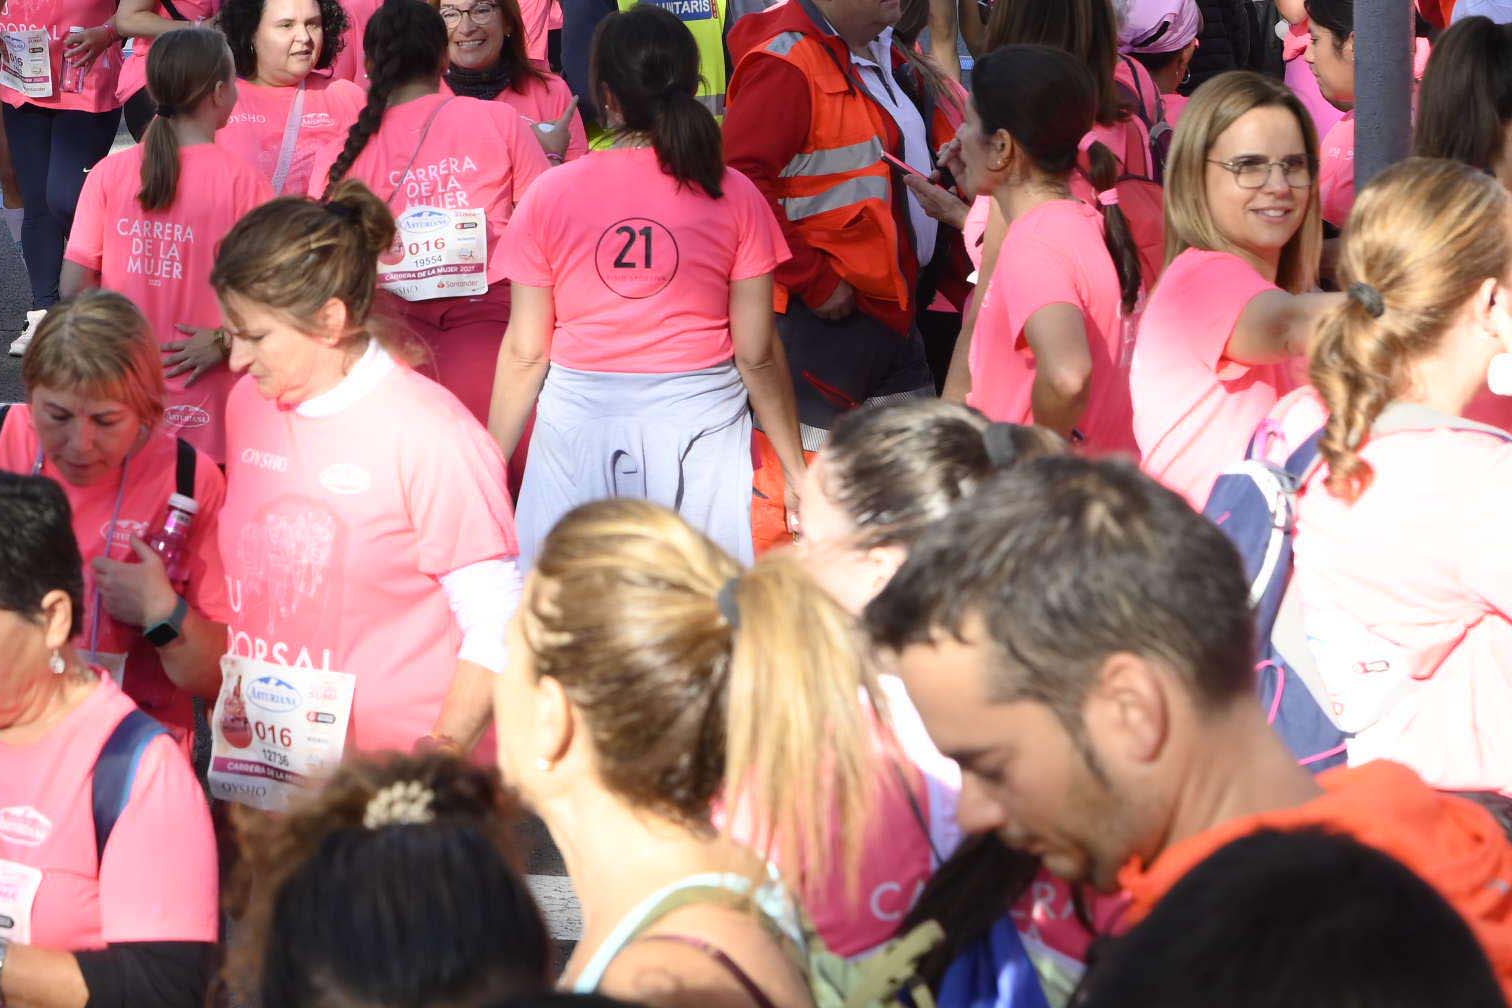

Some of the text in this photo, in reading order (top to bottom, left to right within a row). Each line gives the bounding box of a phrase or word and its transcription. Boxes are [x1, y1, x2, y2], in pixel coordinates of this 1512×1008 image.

[389, 155, 477, 186] CARRERA
[406, 174, 463, 198] DE LA
[117, 218, 195, 243] CARRERA
[131, 237, 181, 260] DE LA
[408, 237, 446, 257] 016
[614, 225, 653, 270] 21
[127, 259, 183, 280] MUJER
[413, 254, 444, 269] 19554
[241, 447, 288, 473] OYSHO
[255, 721, 292, 748] 016
